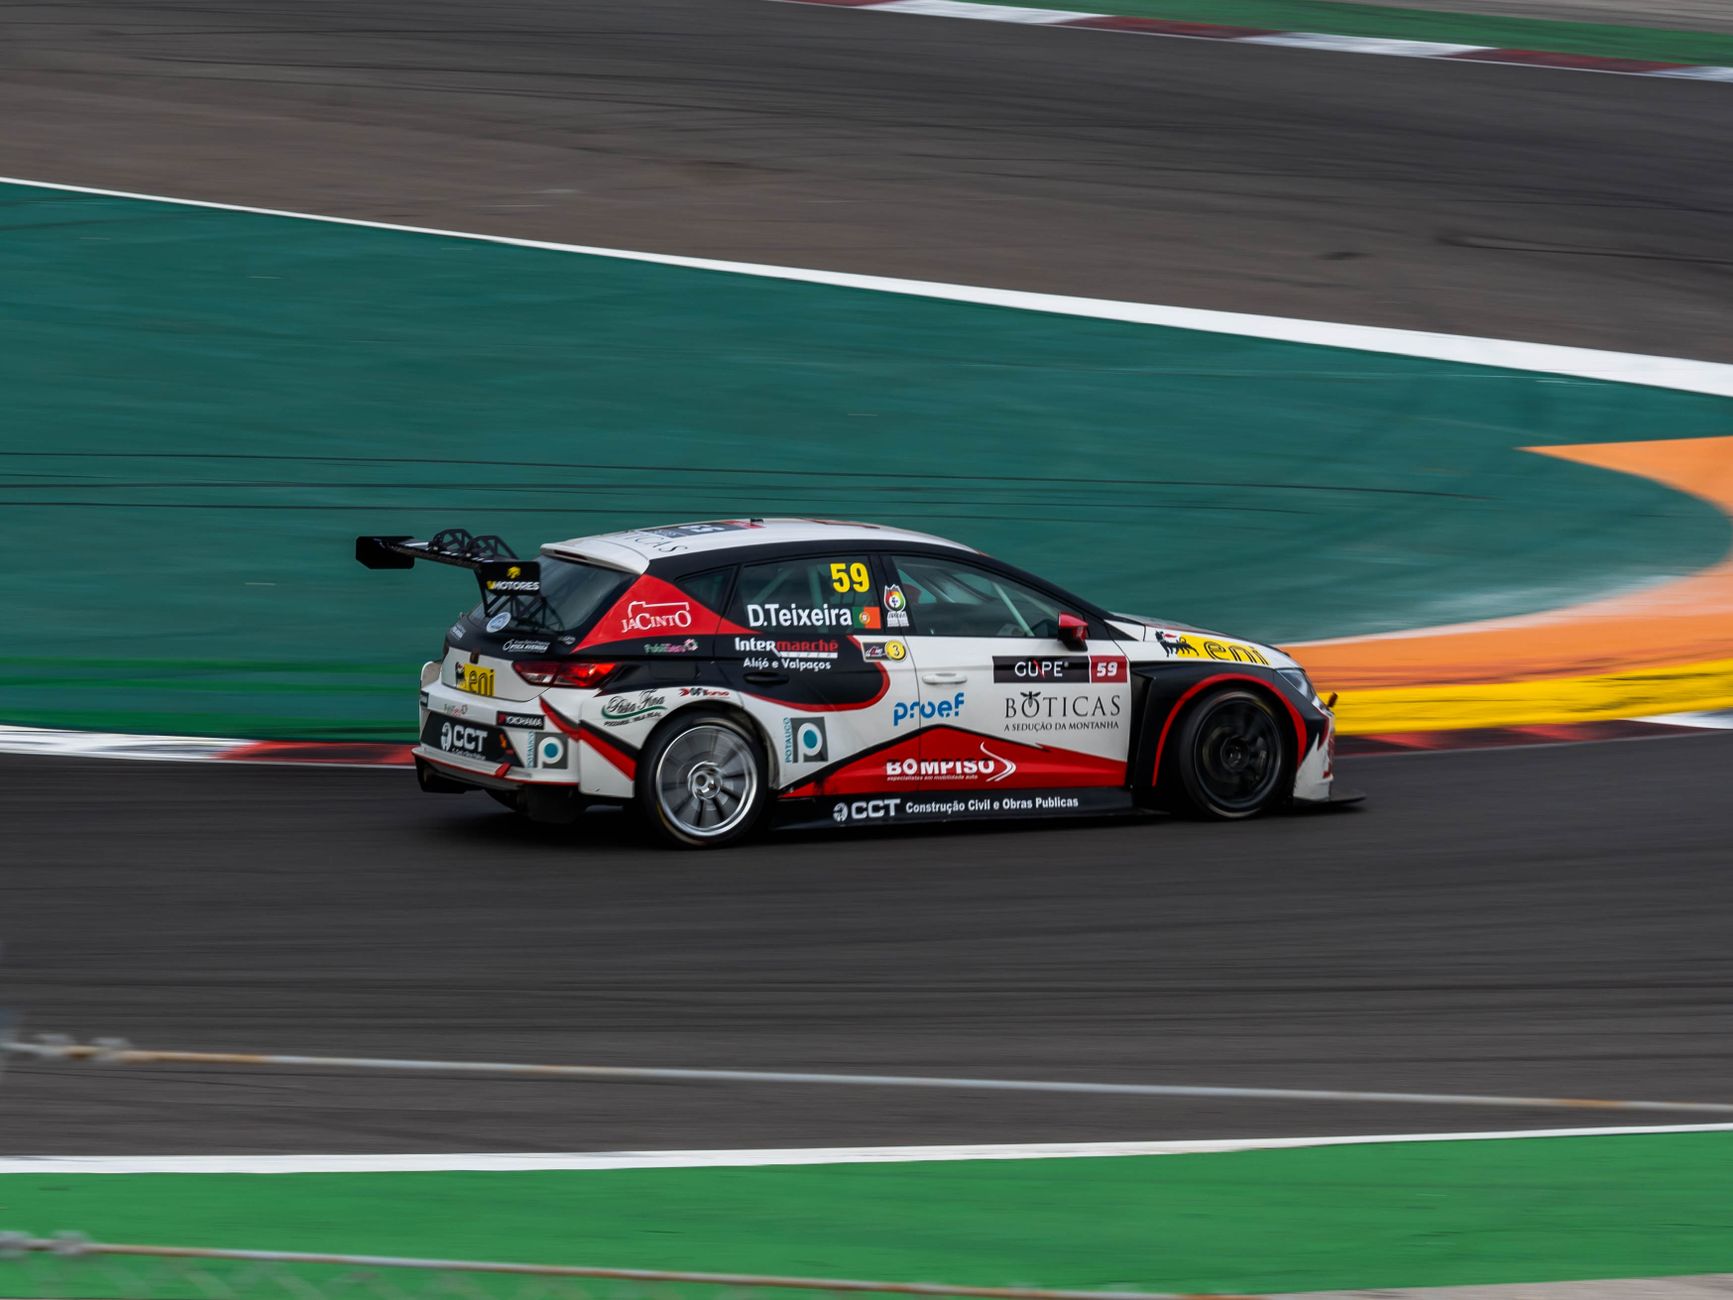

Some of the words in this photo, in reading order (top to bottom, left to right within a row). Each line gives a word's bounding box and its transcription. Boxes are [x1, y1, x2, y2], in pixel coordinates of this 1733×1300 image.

[830, 562, 870, 593] 59
[747, 603, 853, 627] D.Teixeira
[892, 644, 900, 657] 3
[1203, 640, 1270, 666] eni
[772, 660, 779, 668] e
[781, 658, 831, 672] Valpaços
[1096, 661, 1118, 677] 59
[469, 669, 495, 697] eni
[893, 692, 965, 726] proef
[1005, 693, 1121, 719] BOTICAS
[453, 725, 488, 752] CCT
[1003, 723, 1010, 732] A
[1011, 721, 1053, 732] SEDUÇÃO
[1055, 722, 1067, 730] DA
[1068, 720, 1119, 730] MONTANHA
[851, 798, 901, 819] CCT
[905, 800, 965, 814] Construção
[968, 799, 990, 811] Civil
[993, 800, 1000, 810] e
[1002, 798, 1033, 809] Obras
[1035, 796, 1079, 808] Publicas
